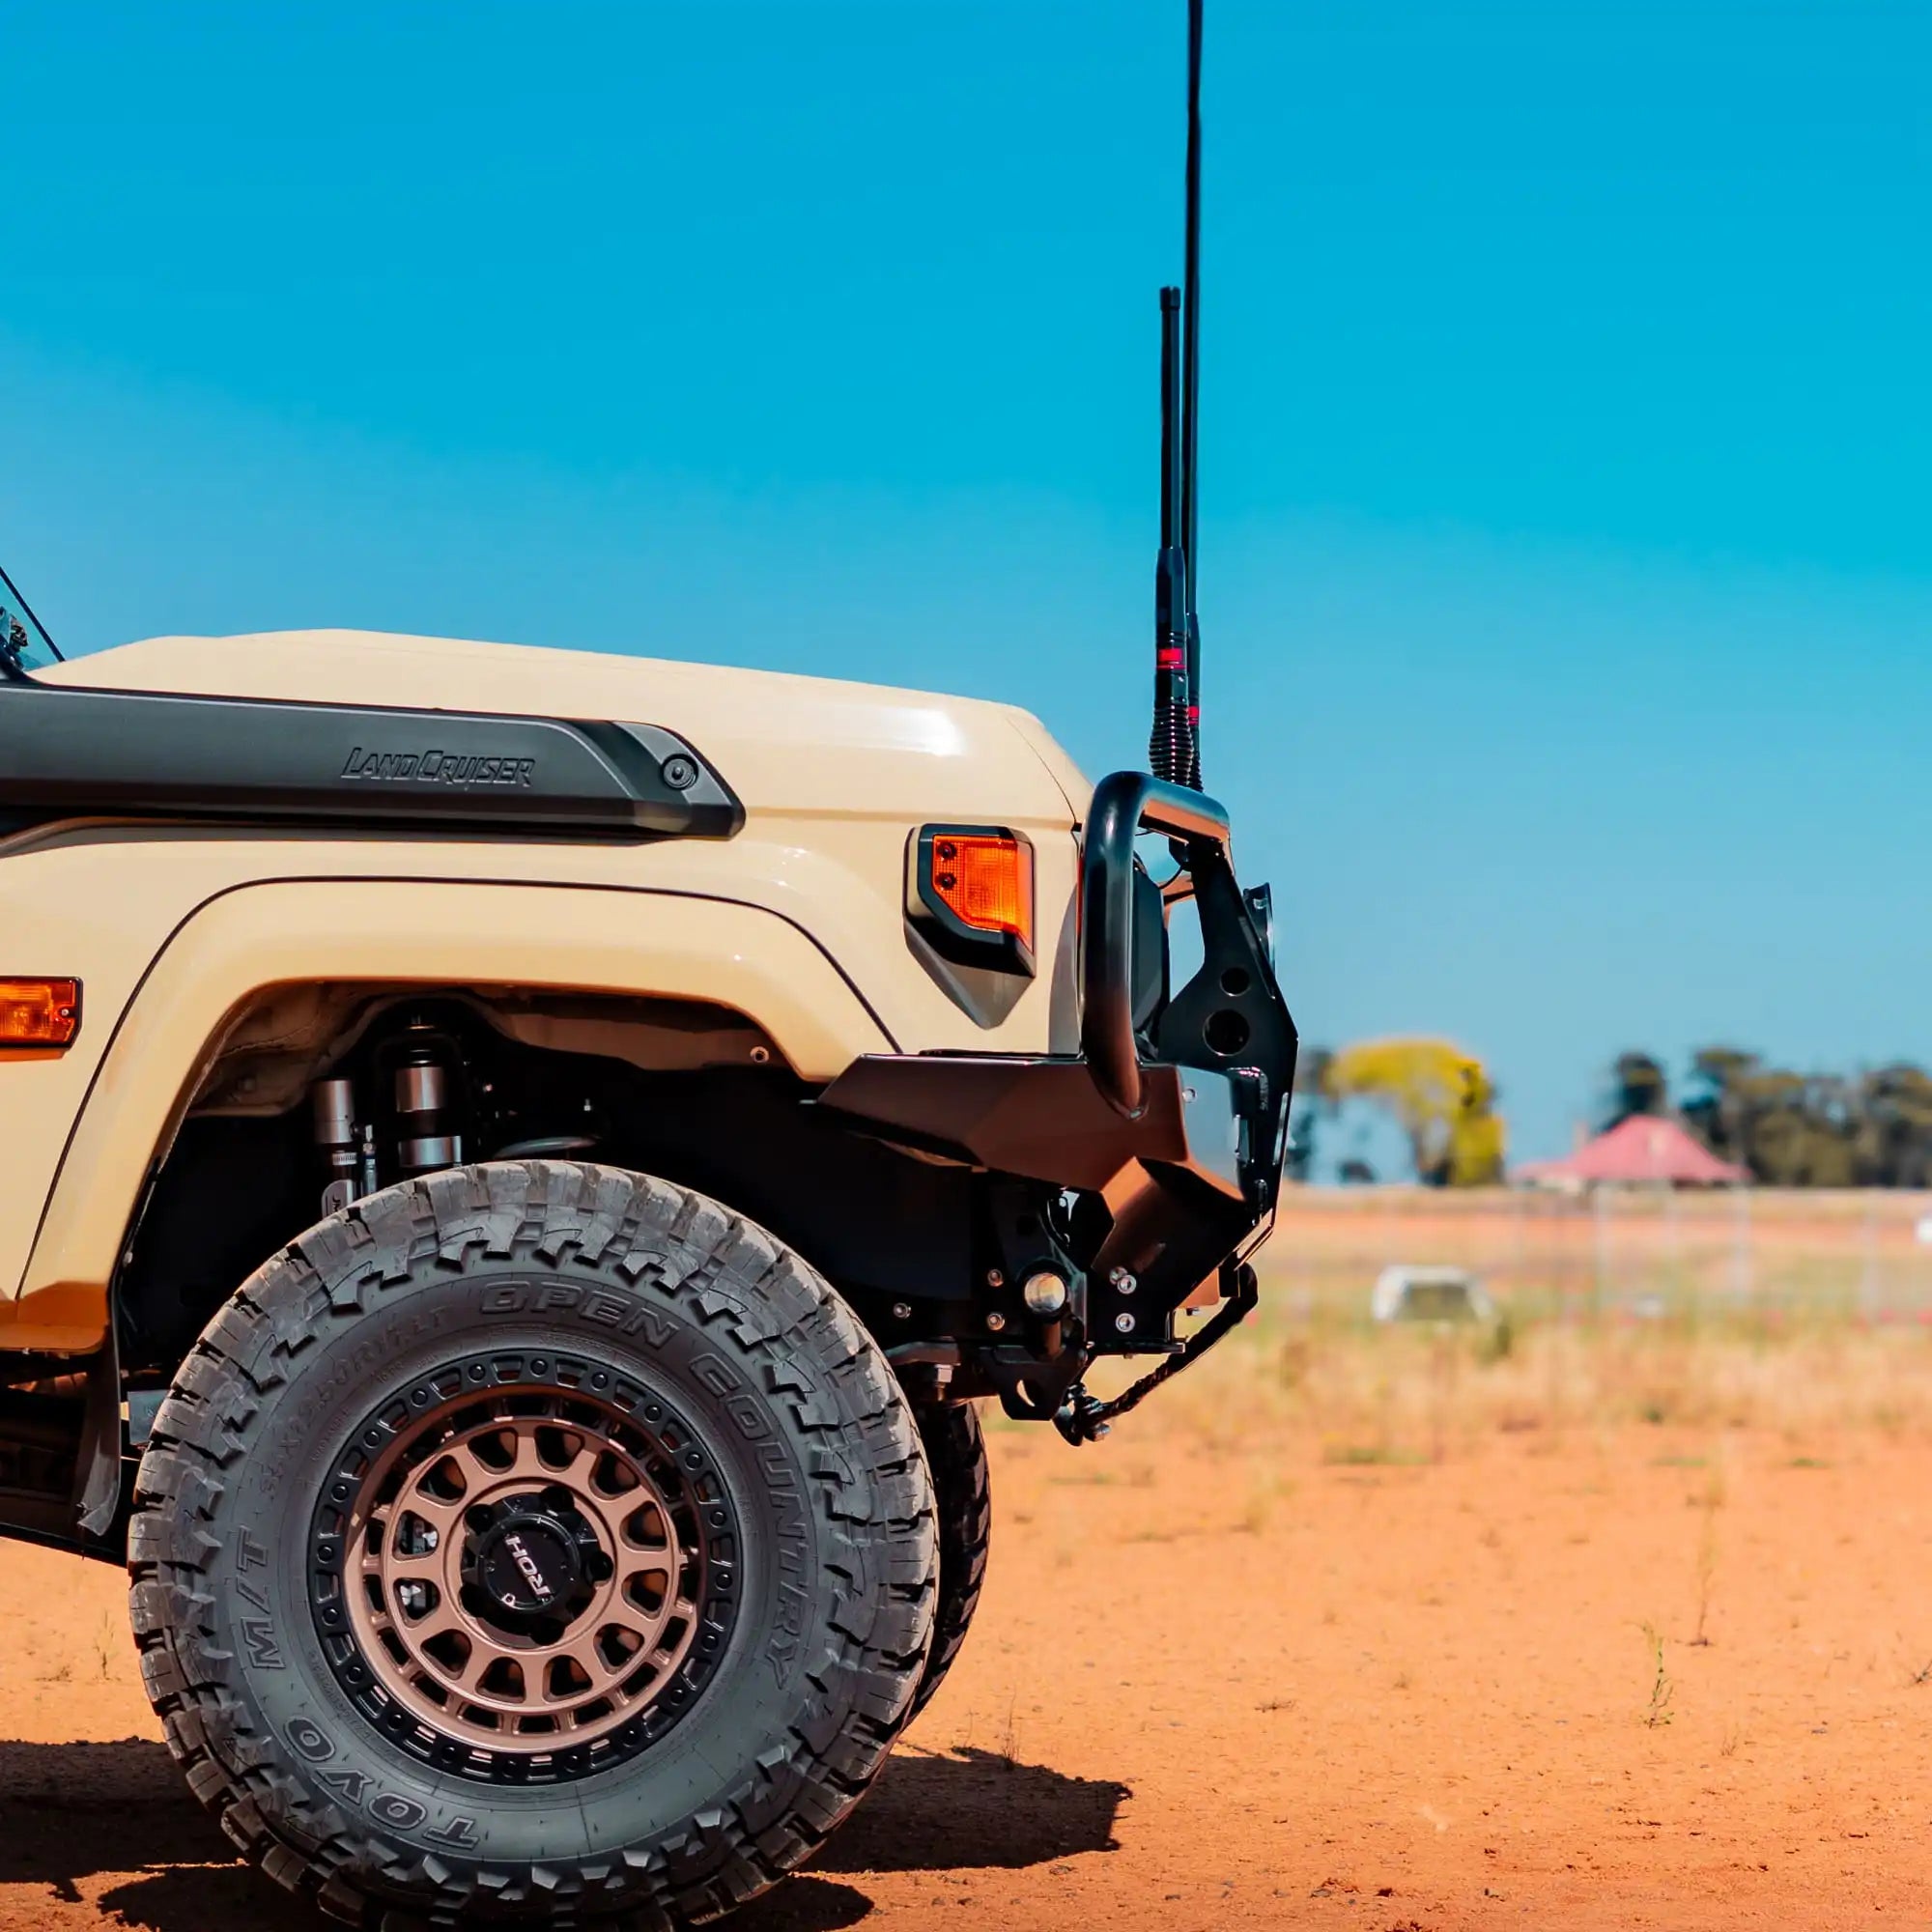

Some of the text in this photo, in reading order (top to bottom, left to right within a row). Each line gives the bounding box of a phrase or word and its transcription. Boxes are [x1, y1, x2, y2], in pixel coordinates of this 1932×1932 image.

[479, 1280, 680, 1350] OPEN
[687, 1352, 810, 1690] COUNTRY
[237, 1524, 287, 1669] M/T
[504, 1535, 552, 1597] ROH
[283, 1716, 480, 1849] TOYO
